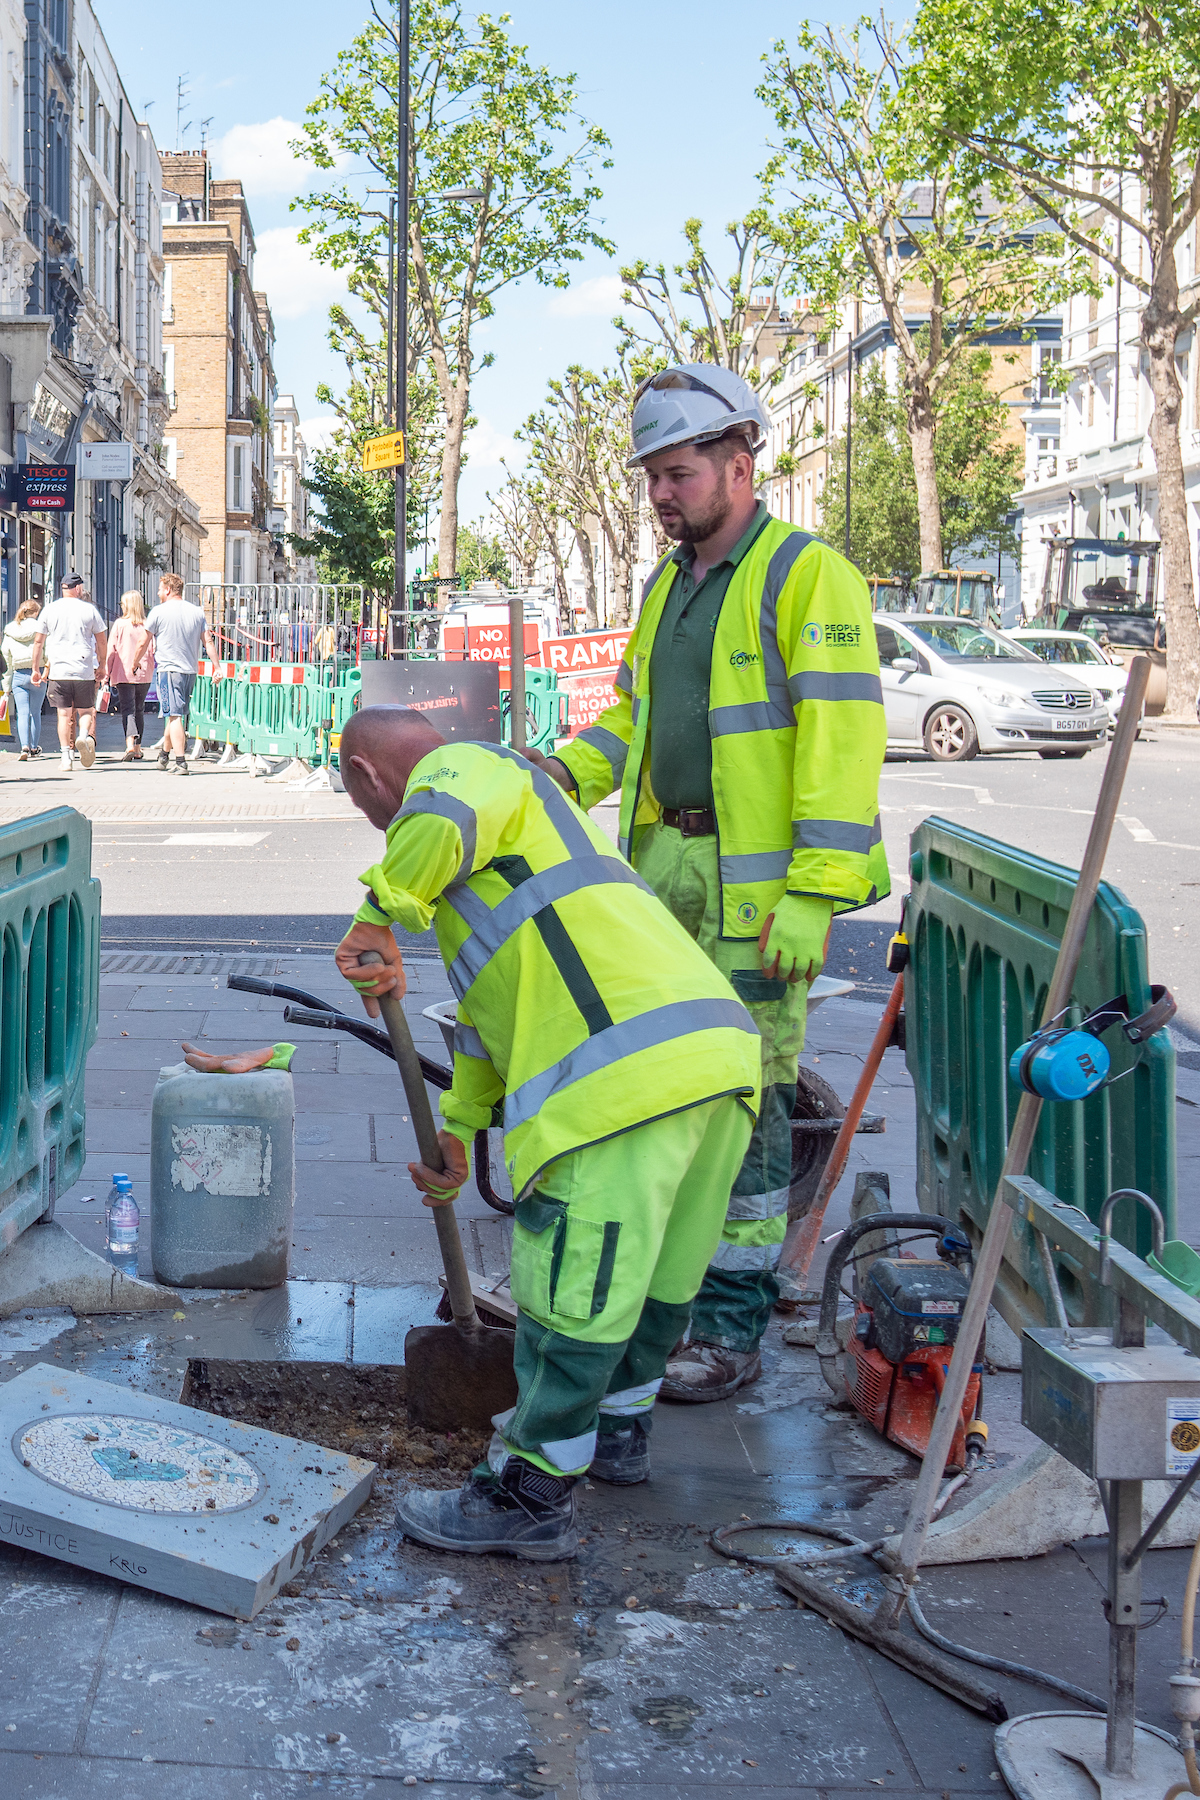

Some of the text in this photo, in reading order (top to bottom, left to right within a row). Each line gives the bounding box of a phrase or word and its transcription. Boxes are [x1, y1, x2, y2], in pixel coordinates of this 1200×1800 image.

[26, 468, 68, 477] TESCO
[26, 483, 68, 494] express
[825, 624, 860, 632] PEOPLE
[479, 629, 503, 643] NO
[825, 632, 861, 643] FIRST
[471, 646, 511, 661] ROAD
[550, 637, 629, 668] RAMP
[730, 652, 759, 666] CONW
[579, 694, 620, 711] ROAD
[567, 710, 599, 726] SUR
[1056, 720, 1076, 729] BG57
[1076, 1053, 1098, 1078] OX
[62, 1421, 253, 1486] JUSTICE
[109, 1553, 148, 1577] KRIO
